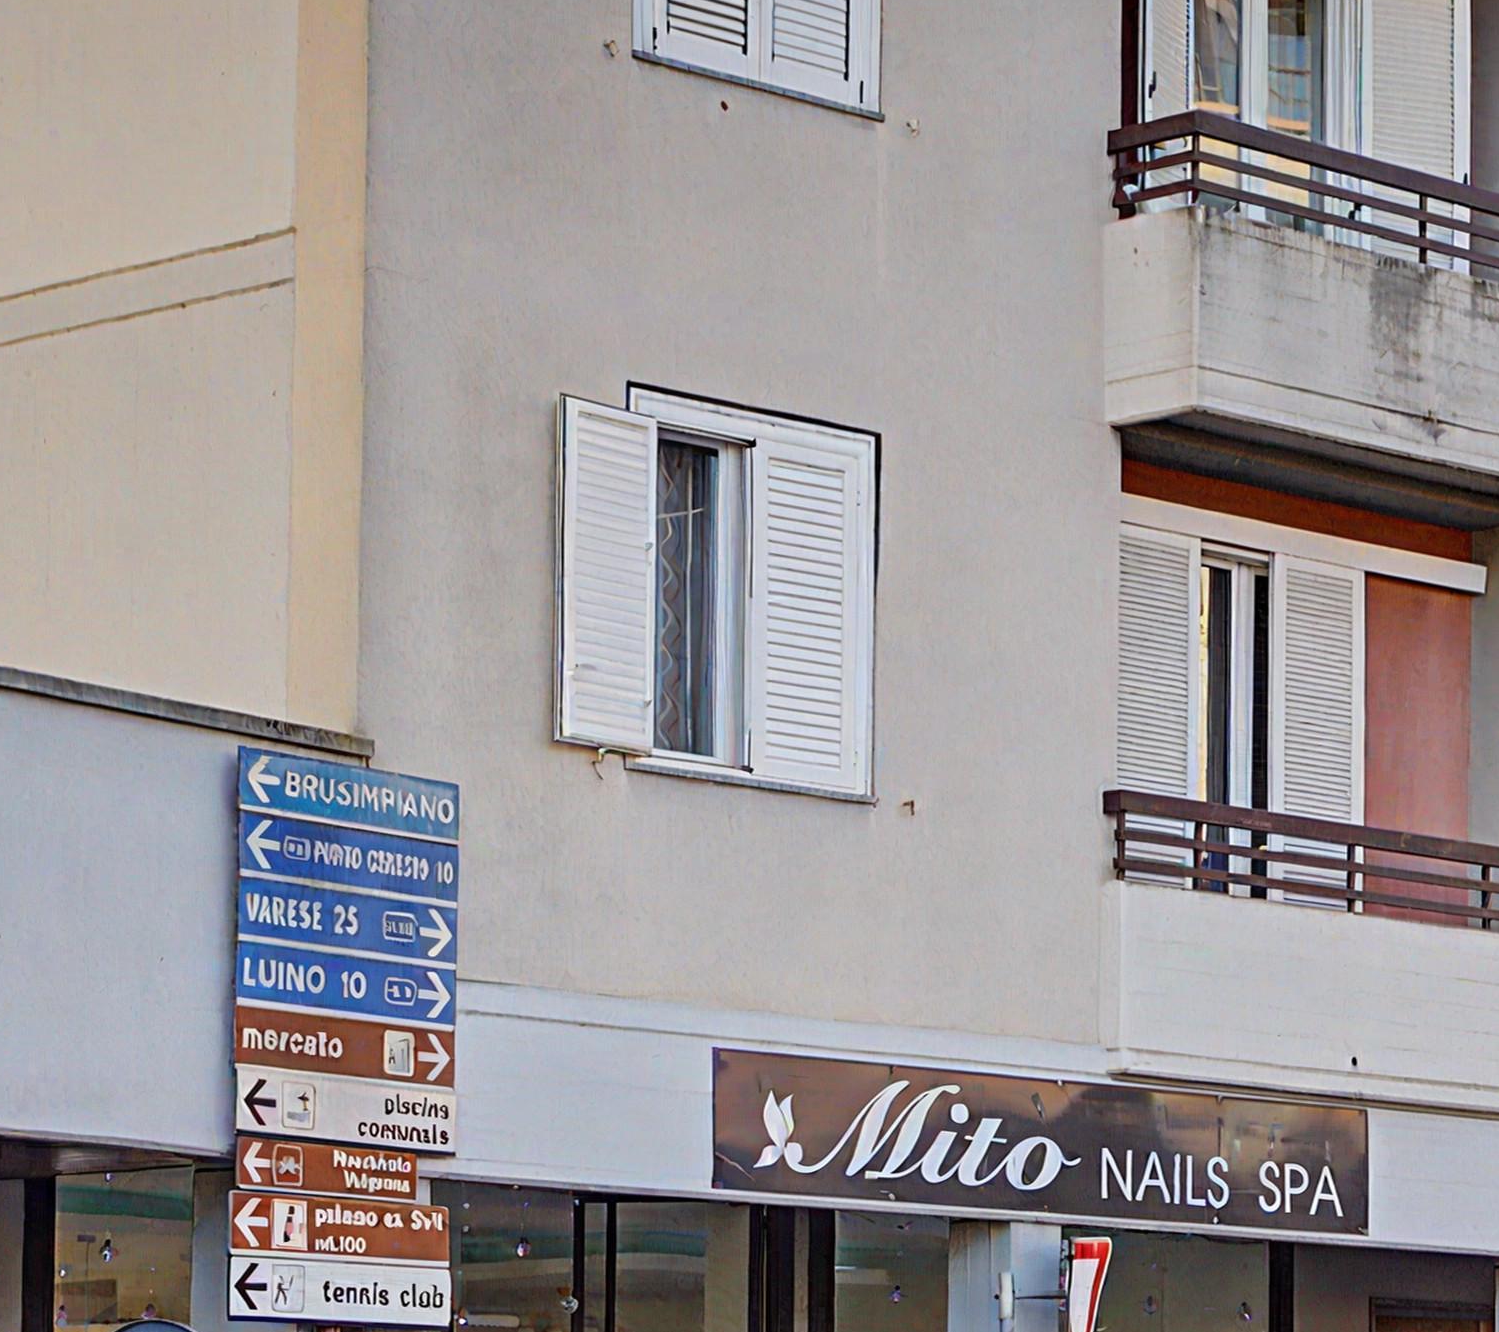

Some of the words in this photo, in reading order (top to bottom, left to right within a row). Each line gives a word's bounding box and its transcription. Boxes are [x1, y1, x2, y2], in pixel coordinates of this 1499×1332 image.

[285, 770, 455, 824] BRUSIMPIANO
[436, 861, 454, 884] 10
[245, 892, 323, 932] VARESE
[333, 903, 359, 935] 25
[243, 957, 326, 994] LUINO
[340, 970, 367, 999] 10
[242, 1027, 344, 1059] mercato
[797, 1079, 1081, 1191] Mito
[1100, 1146, 1230, 1208] NAILS
[1257, 1160, 1344, 1217] SPA
[322, 1280, 389, 1306] tennis
[399, 1283, 444, 1309] club
